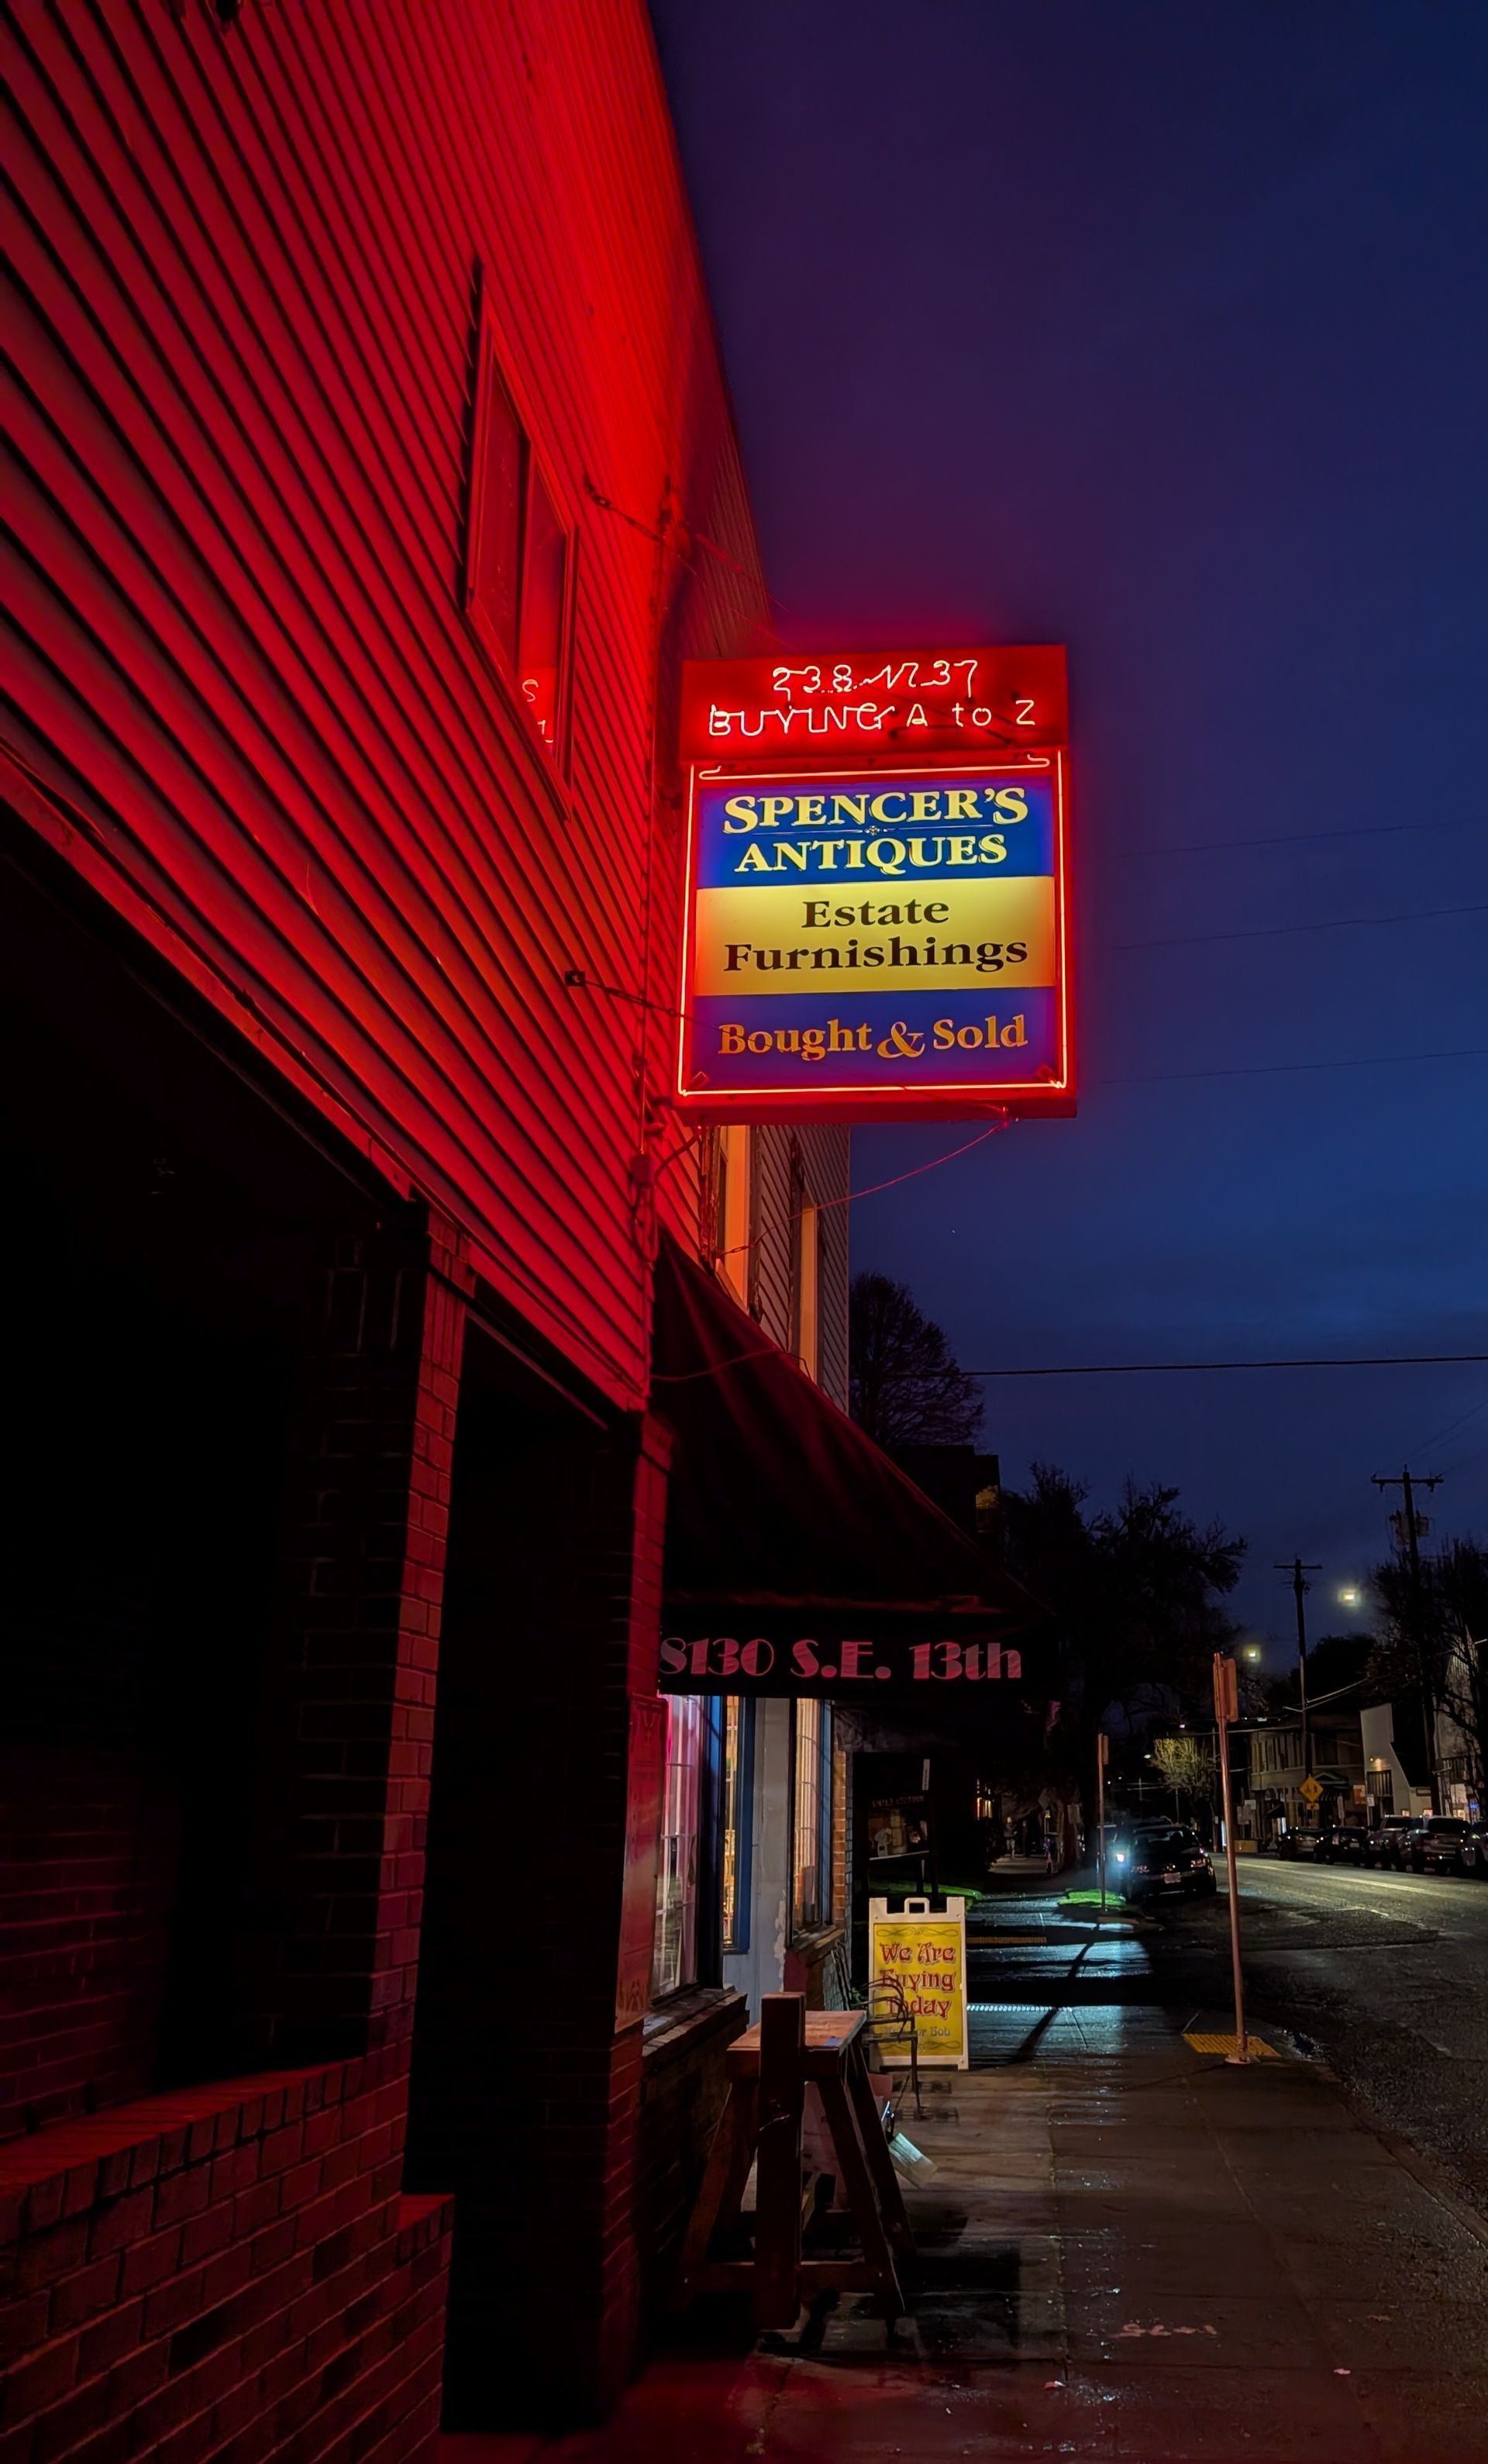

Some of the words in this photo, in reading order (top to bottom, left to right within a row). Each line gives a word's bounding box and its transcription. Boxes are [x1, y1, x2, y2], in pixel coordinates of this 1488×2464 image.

[708, 702, 896, 736] BUYING
[906, 703, 928, 728] A
[951, 701, 992, 728] to
[1015, 699, 1035, 725] Z
[722, 787, 1029, 835] SPENCER'S
[733, 834, 1008, 875] ANTIQUES
[801, 898, 950, 929] Estate
[722, 936, 1028, 974] Furnishings
[718, 1018, 873, 1062] Bought
[876, 1020, 926, 1059] &
[932, 1014, 1029, 1049] Sold
[659, 1637, 775, 1677] 8130
[790, 1639, 892, 1680] S.E.
[908, 1641, 1023, 1680] 13th
[879, 1942, 912, 1964] We
[917, 1942, 956, 1965] Are
[930, 2025, 951, 2038] Bob
